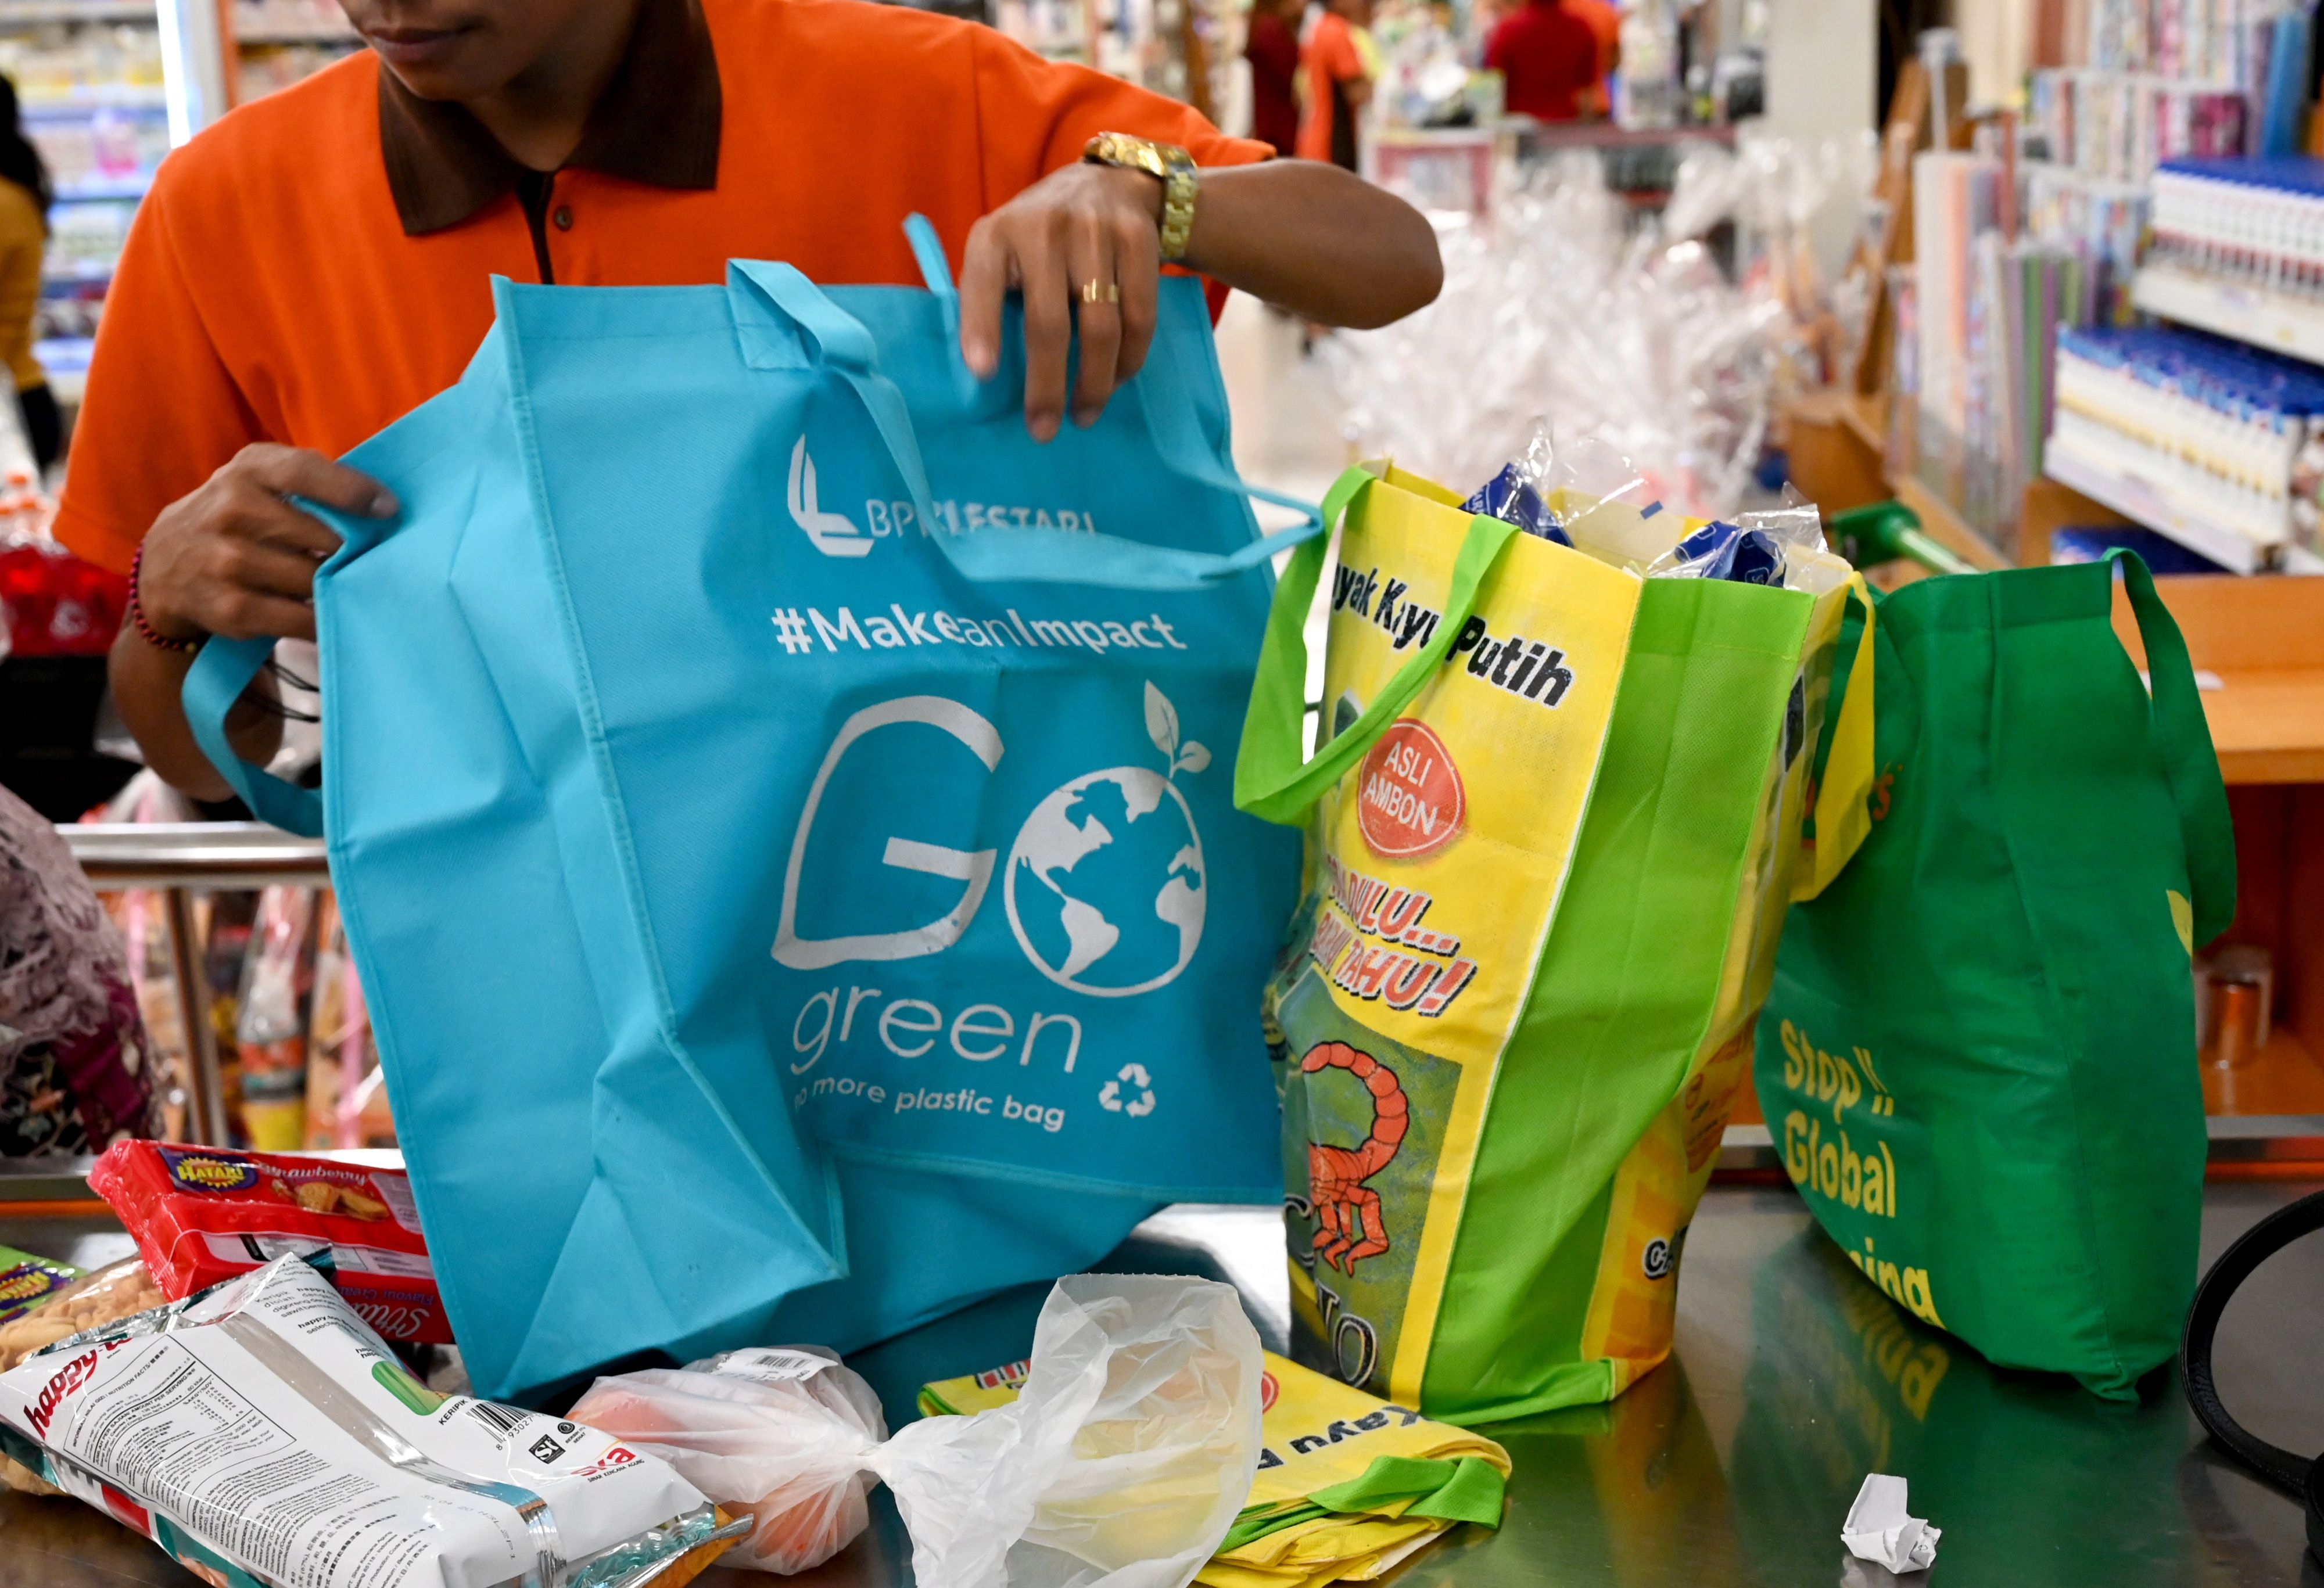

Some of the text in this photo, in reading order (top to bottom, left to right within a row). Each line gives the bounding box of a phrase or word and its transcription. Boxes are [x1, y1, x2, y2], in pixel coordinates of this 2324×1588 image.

[772, 603, 1188, 655] #MakeanImpact
[1445, 614, 1573, 707] Putih
[1385, 739, 1432, 788] ASLI
[1364, 771, 1438, 836] AMBON
[790, 986, 1083, 1075] green
[813, 1076, 887, 1103] more
[894, 1087, 994, 1115] plastic
[1002, 1094, 1065, 1133] bag
[1784, 1108, 1896, 1218] Global
[107, 1377, 134, 1396] NUTRITION
[368, 1554, 390, 1582] Production
